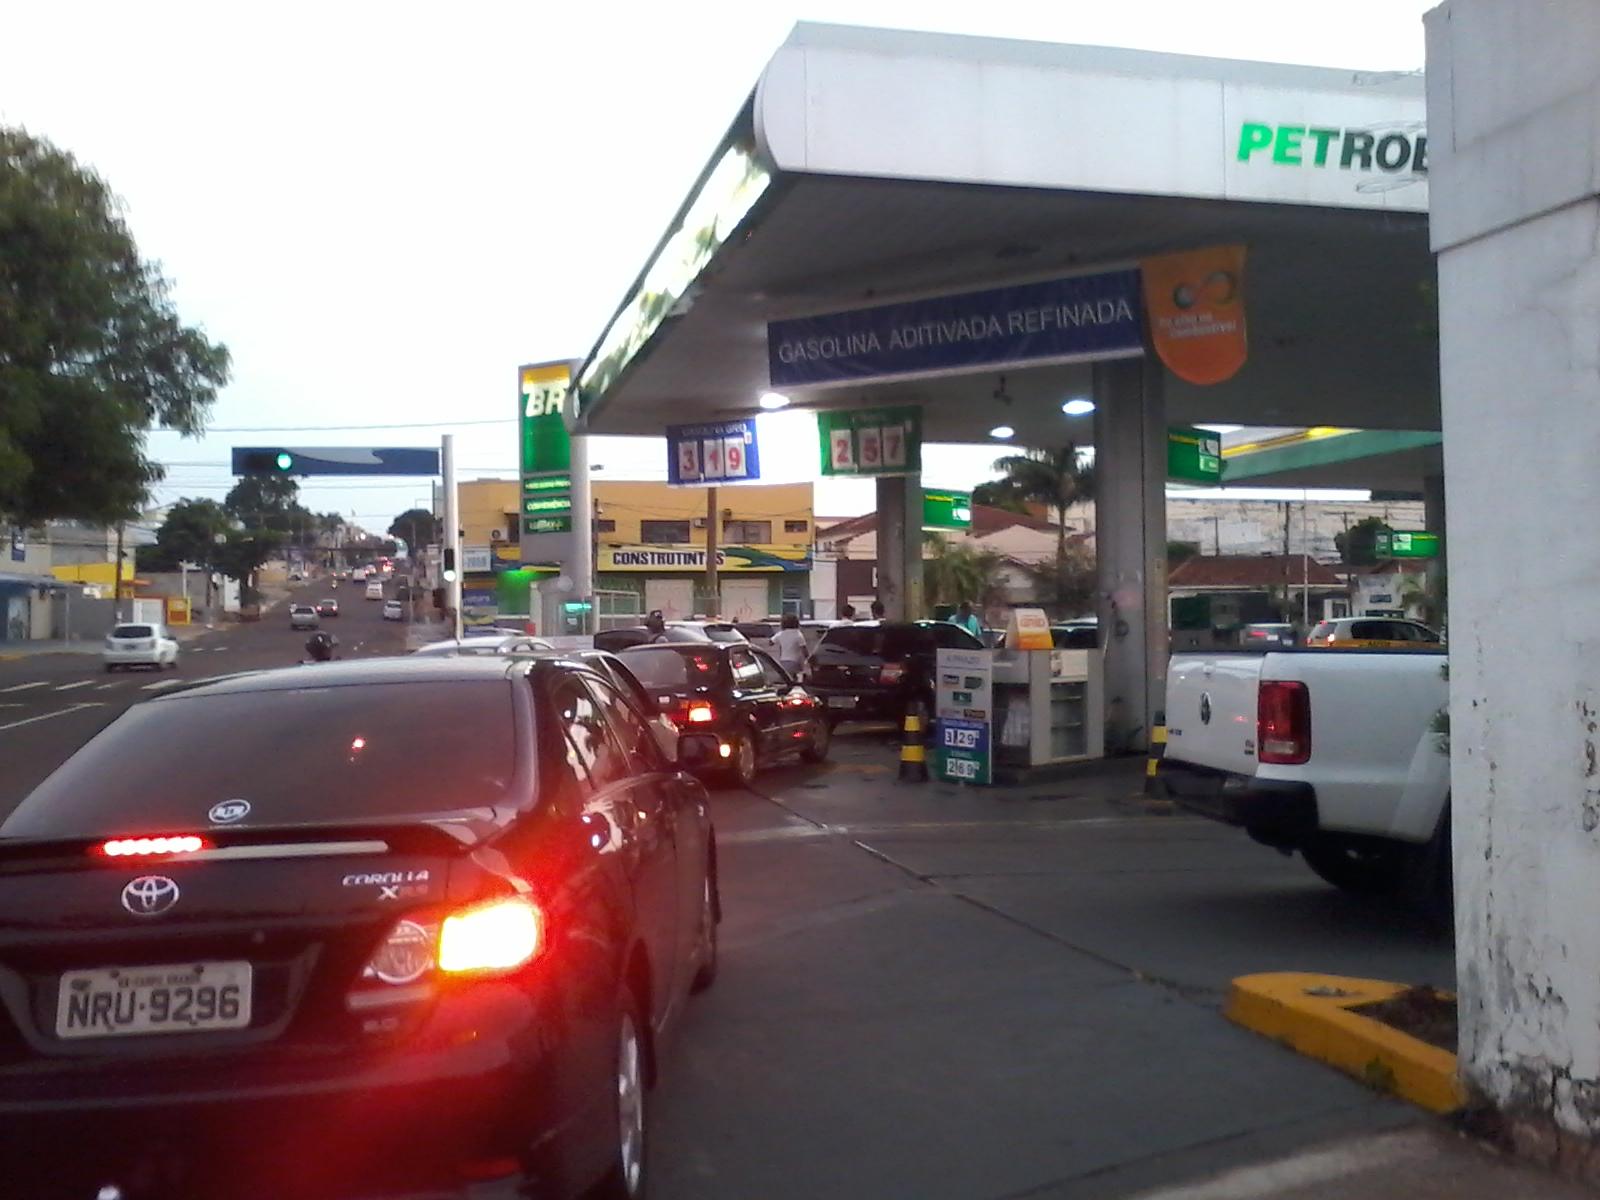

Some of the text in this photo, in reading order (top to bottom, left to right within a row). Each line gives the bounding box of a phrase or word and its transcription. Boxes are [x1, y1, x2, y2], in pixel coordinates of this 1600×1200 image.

[778, 331, 881, 364] GASOLINA
[889, 315, 1003, 350] ADITIVADA
[1007, 298, 1133, 336] REFINADA
[524, 386, 567, 418] BR
[612, 551, 725, 566] CONSTRUTINTS
